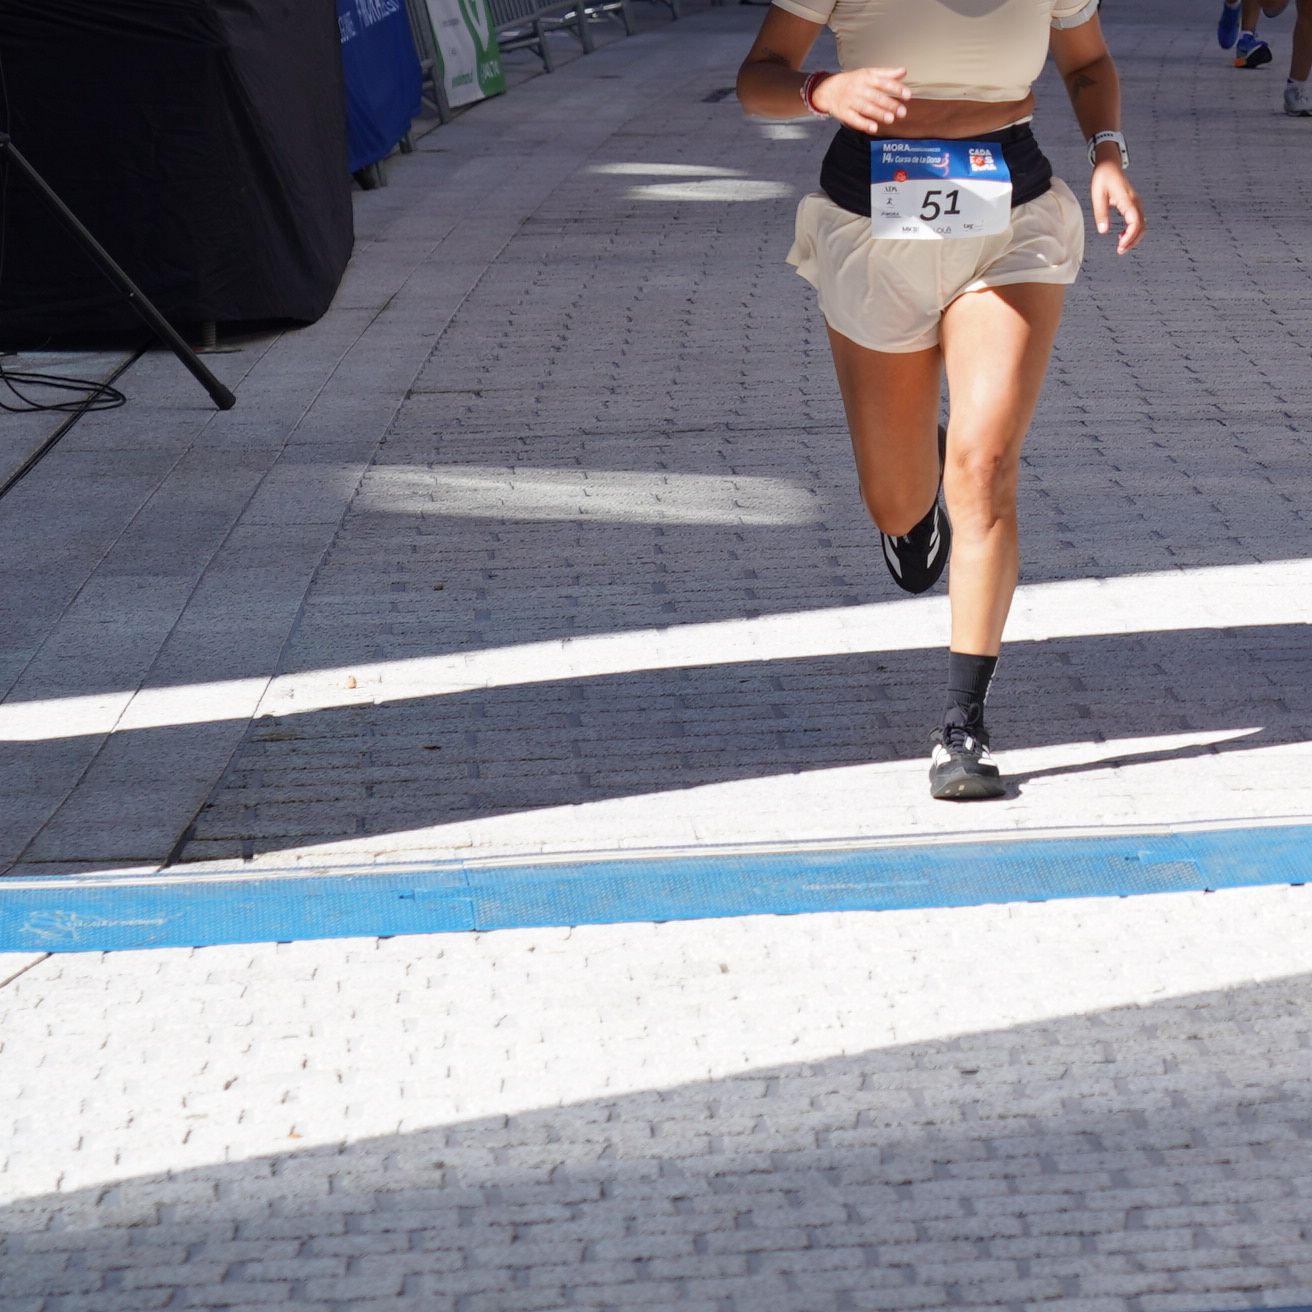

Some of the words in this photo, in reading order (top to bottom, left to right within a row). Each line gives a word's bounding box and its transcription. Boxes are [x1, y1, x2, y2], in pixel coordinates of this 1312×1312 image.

[883, 143, 910, 152] MORA
[969, 148, 992, 156] CADA
[919, 189, 961, 222] 51
